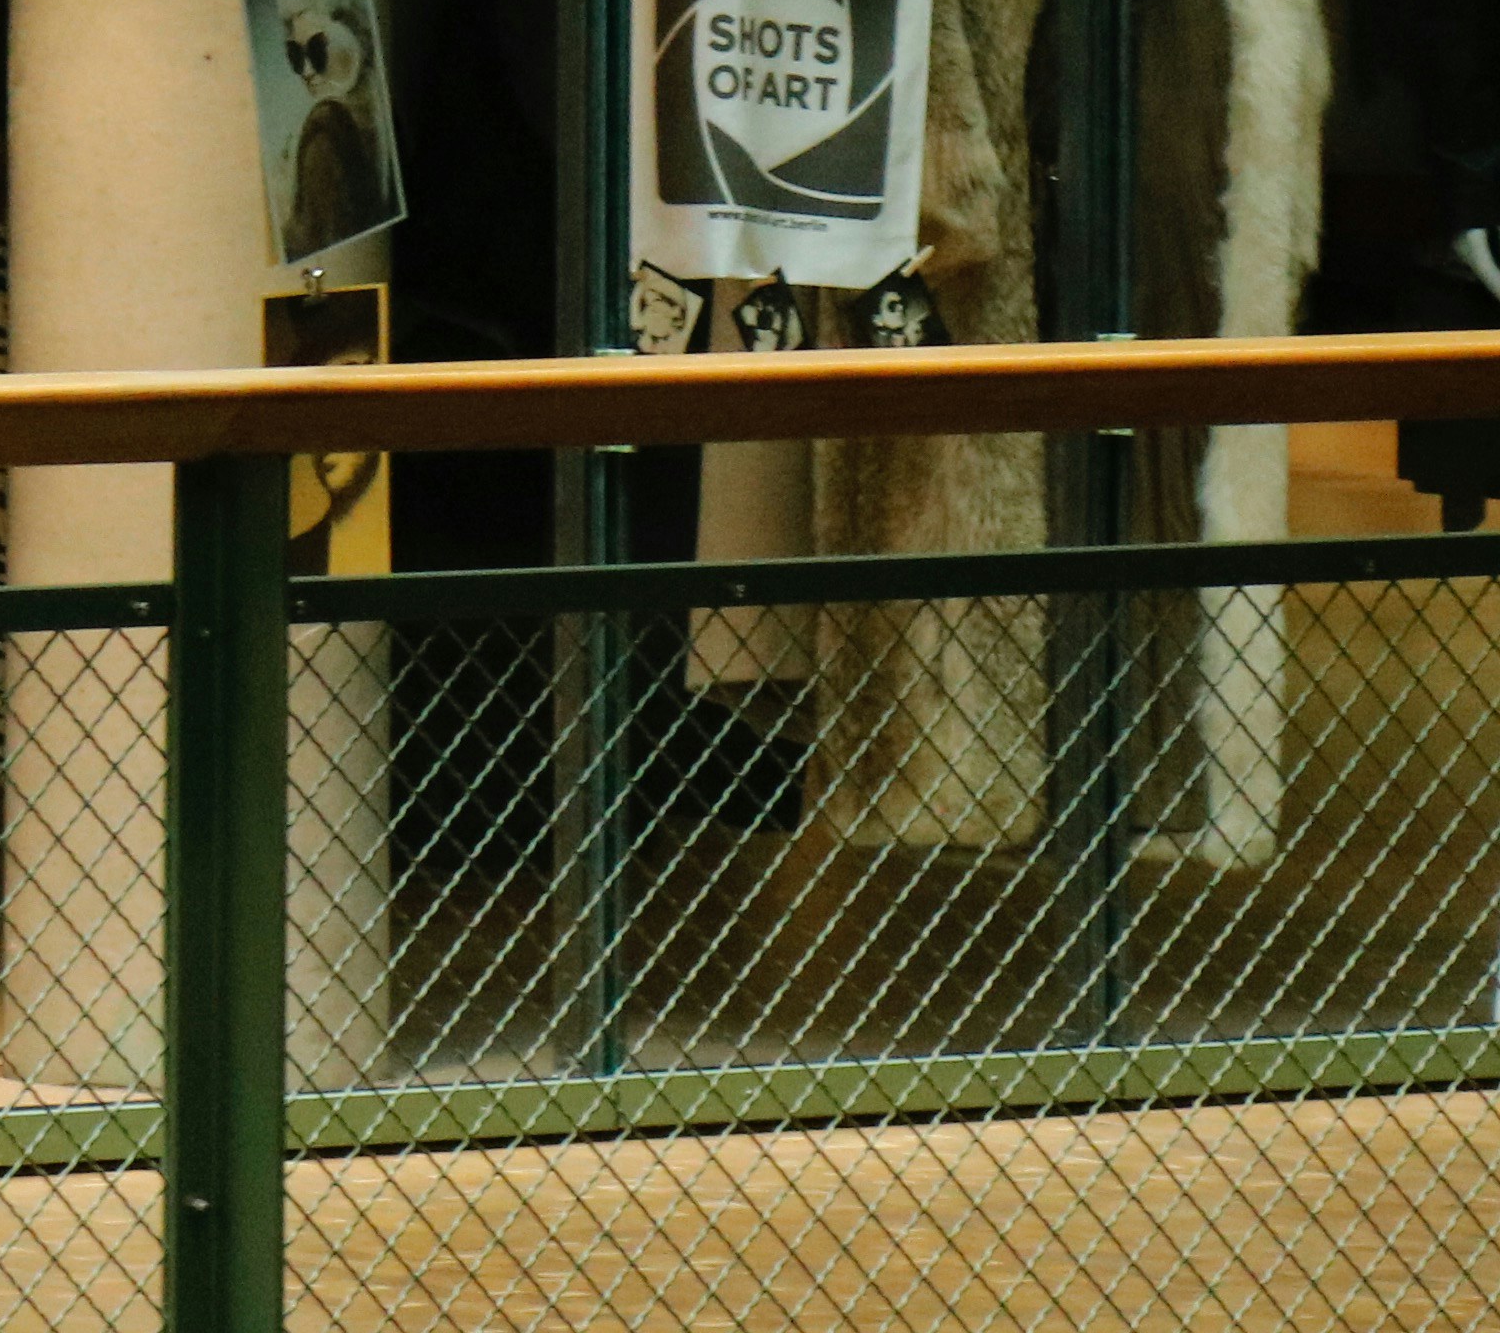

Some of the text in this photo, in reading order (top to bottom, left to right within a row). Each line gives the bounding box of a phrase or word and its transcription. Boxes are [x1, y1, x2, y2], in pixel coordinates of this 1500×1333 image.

[708, 14, 840, 64] SHOTS
[708, 64, 838, 110] OF ART
